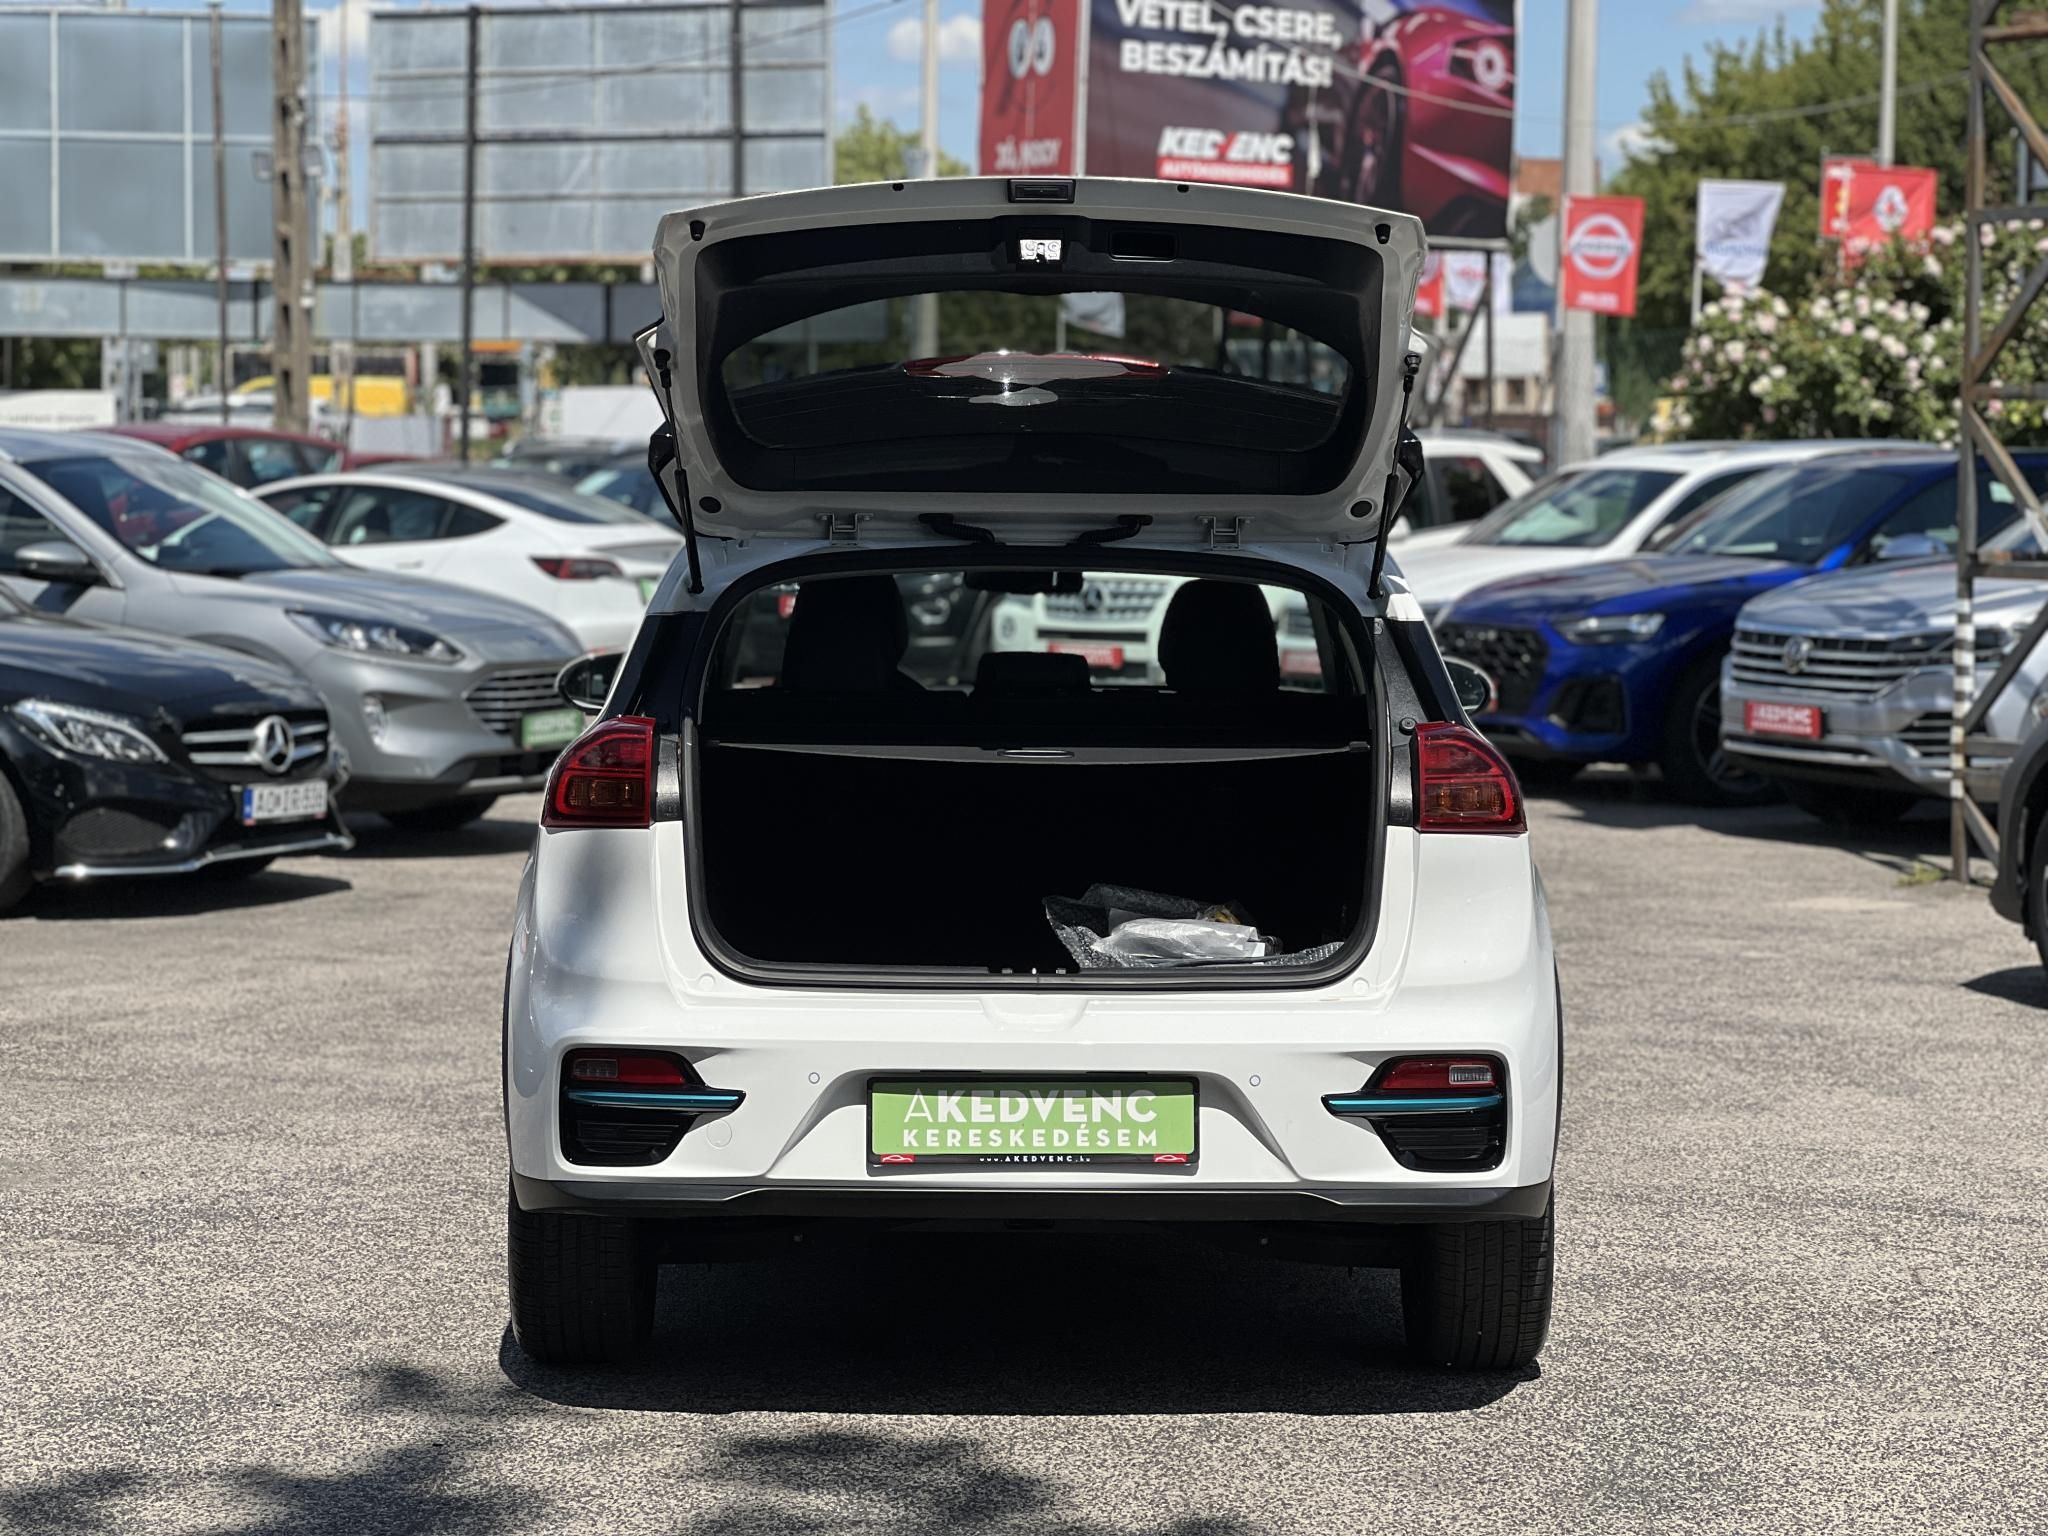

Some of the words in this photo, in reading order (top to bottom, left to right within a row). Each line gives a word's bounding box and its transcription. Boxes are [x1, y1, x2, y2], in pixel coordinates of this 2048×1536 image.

[1233, 4, 1342, 50] CSERE,
[1120, 37, 1333, 87] BESZÁMÍTÁS!
[904, 1088, 1157, 1123] AKEDVENC
[903, 1124, 1157, 1147] KERESKEDÉSEM
